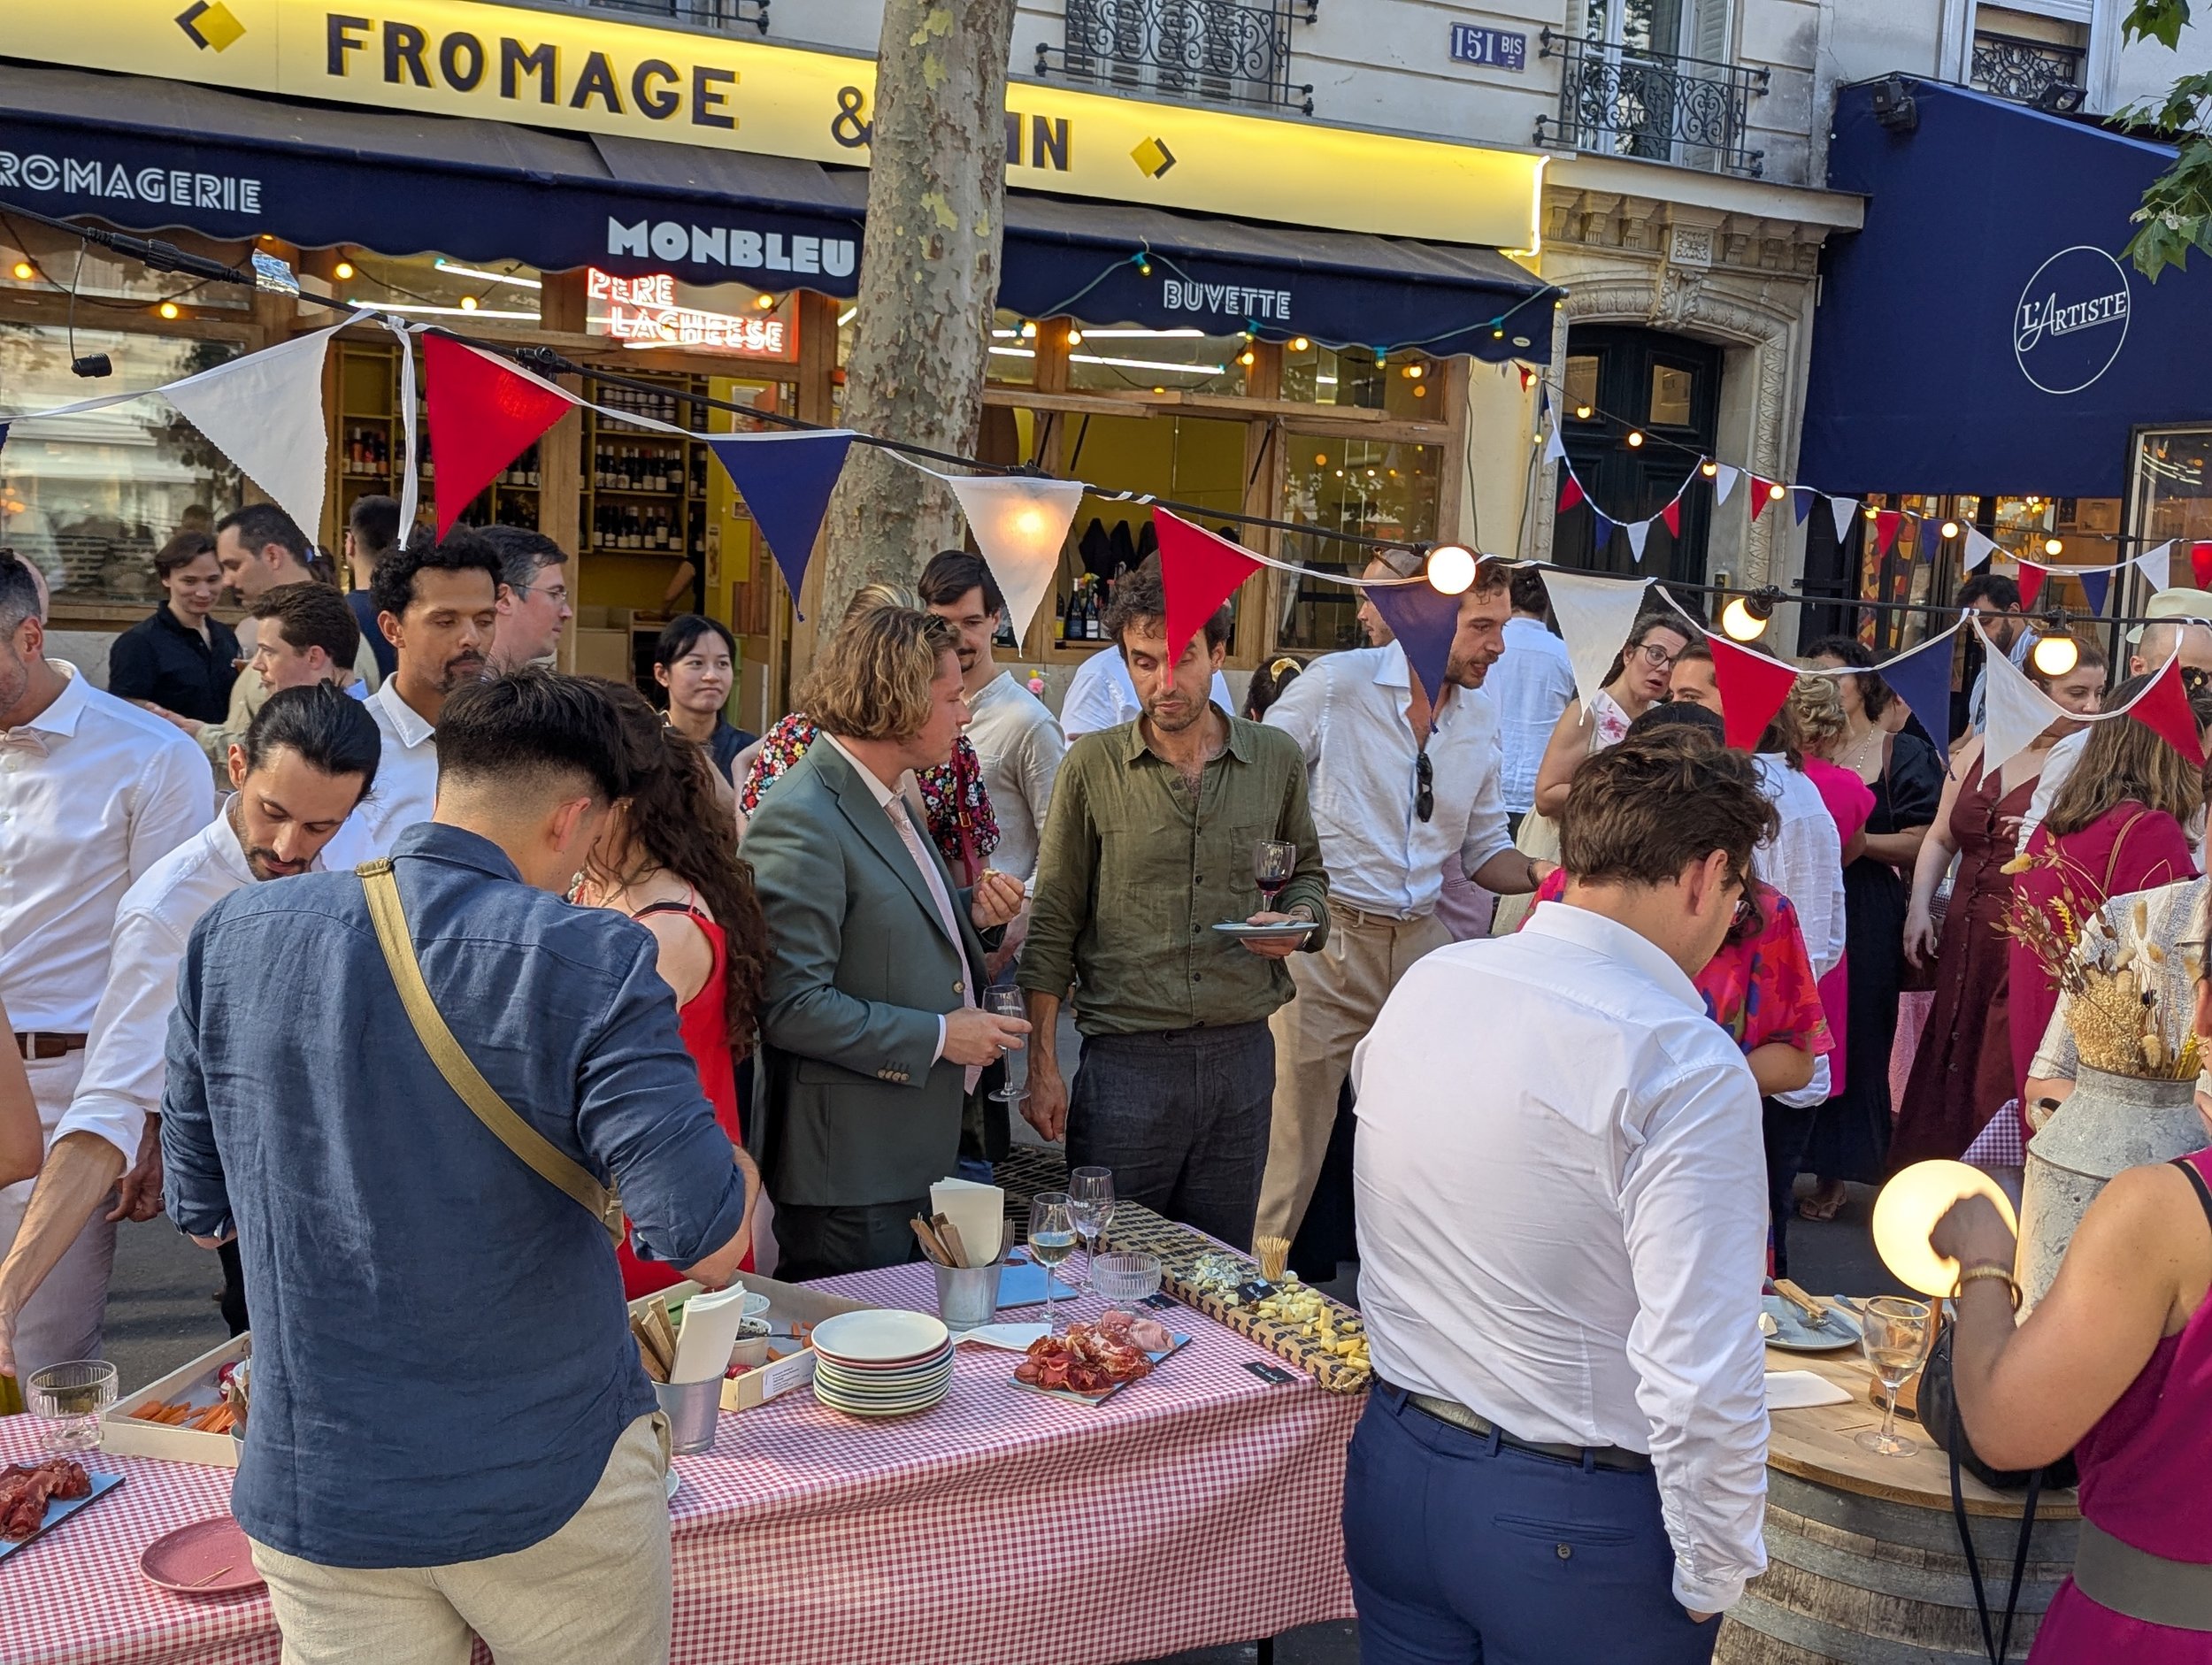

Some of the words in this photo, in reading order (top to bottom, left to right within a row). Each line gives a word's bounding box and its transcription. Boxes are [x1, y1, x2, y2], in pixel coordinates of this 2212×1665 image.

[1455, 27, 1494, 62] 151
[1502, 35, 1522, 55] BIS
[326, 12, 739, 130] FROMAGE
[832, 86, 873, 150] &
[1005, 111, 1072, 172] IN
[0, 150, 262, 214] ROMAGERIE
[608, 216, 855, 277] MONBLEU
[1164, 279, 1291, 319] BUVETTE
[2017, 291, 2126, 352] L'ARTISTE
